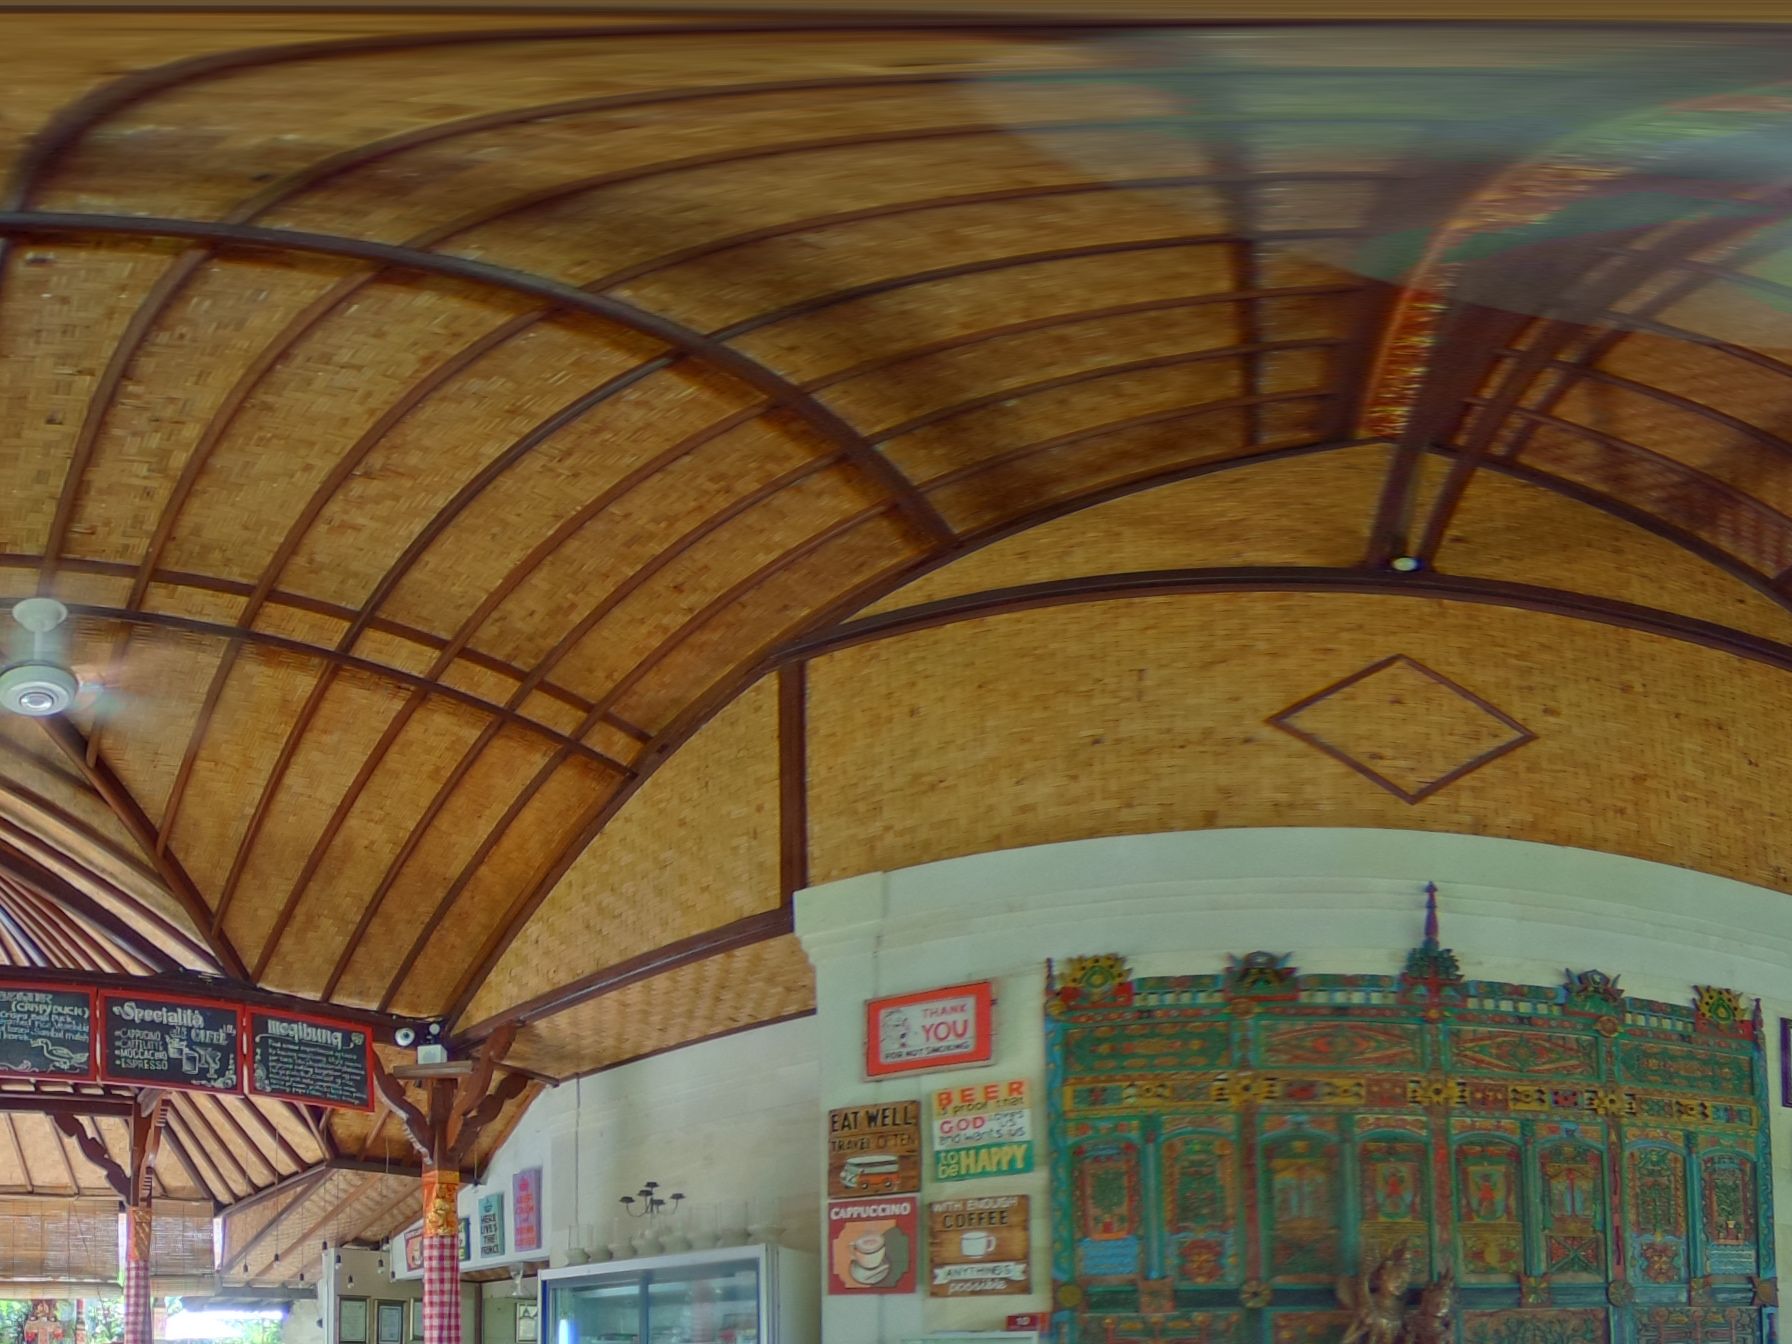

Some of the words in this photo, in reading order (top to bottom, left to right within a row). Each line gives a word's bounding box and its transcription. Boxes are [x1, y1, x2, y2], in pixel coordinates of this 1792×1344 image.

[922, 1003, 968, 1018] THANK
[921, 1019, 968, 1042] YOU
[937, 1081, 1026, 1107] BEER
[830, 1111, 860, 1132] EAT
[865, 1106, 913, 1127] WELL
[940, 1116, 986, 1134] GOD
[831, 1137, 871, 1152] TRAVEL
[960, 1143, 1028, 1174] HAPPY
[830, 1202, 911, 1219] CAPPUCCINO
[932, 1202, 964, 1212] WITH
[966, 1196, 1019, 1210] ENOUGH
[943, 1210, 1009, 1229] COFFEE
[947, 1280, 1008, 1295] possible
